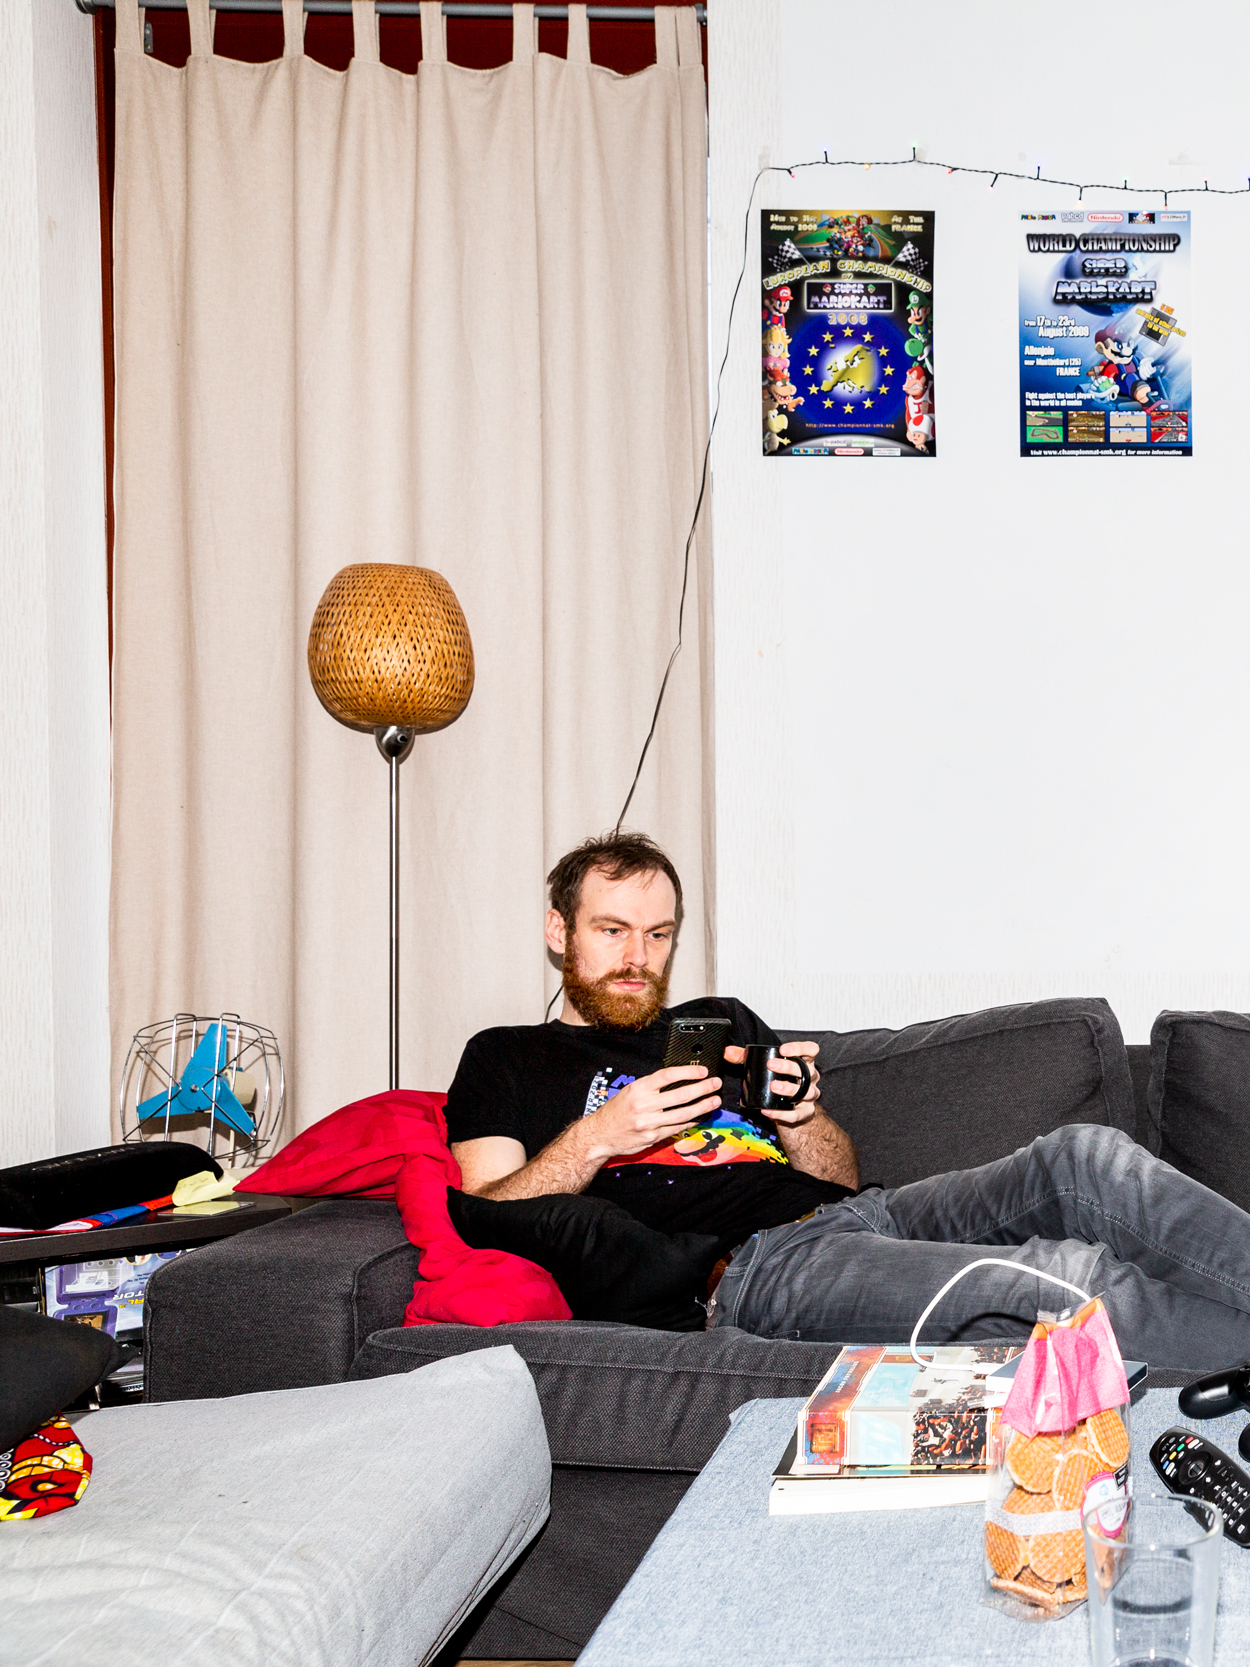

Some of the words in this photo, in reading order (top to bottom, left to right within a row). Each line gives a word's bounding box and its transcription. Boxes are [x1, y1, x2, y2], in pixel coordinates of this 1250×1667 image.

[1027, 233, 1077, 252] WORLD
[1079, 233, 1181, 253] CHAMPIONSHIP
[1083, 258, 1127, 274] SUPER
[763, 260, 831, 290] EUROPEAN
[837, 260, 933, 293] CHAMPIONSHIP
[834, 283, 864, 294] SUPER
[828, 313, 868, 325] 2008
[1036, 315, 1051, 326] 17th
[1058, 315, 1075, 326] 23rd
[1038, 326, 1067, 339] August
[1068, 326, 1089, 337] 2009
[1056, 367, 1081, 376] FRANCE
